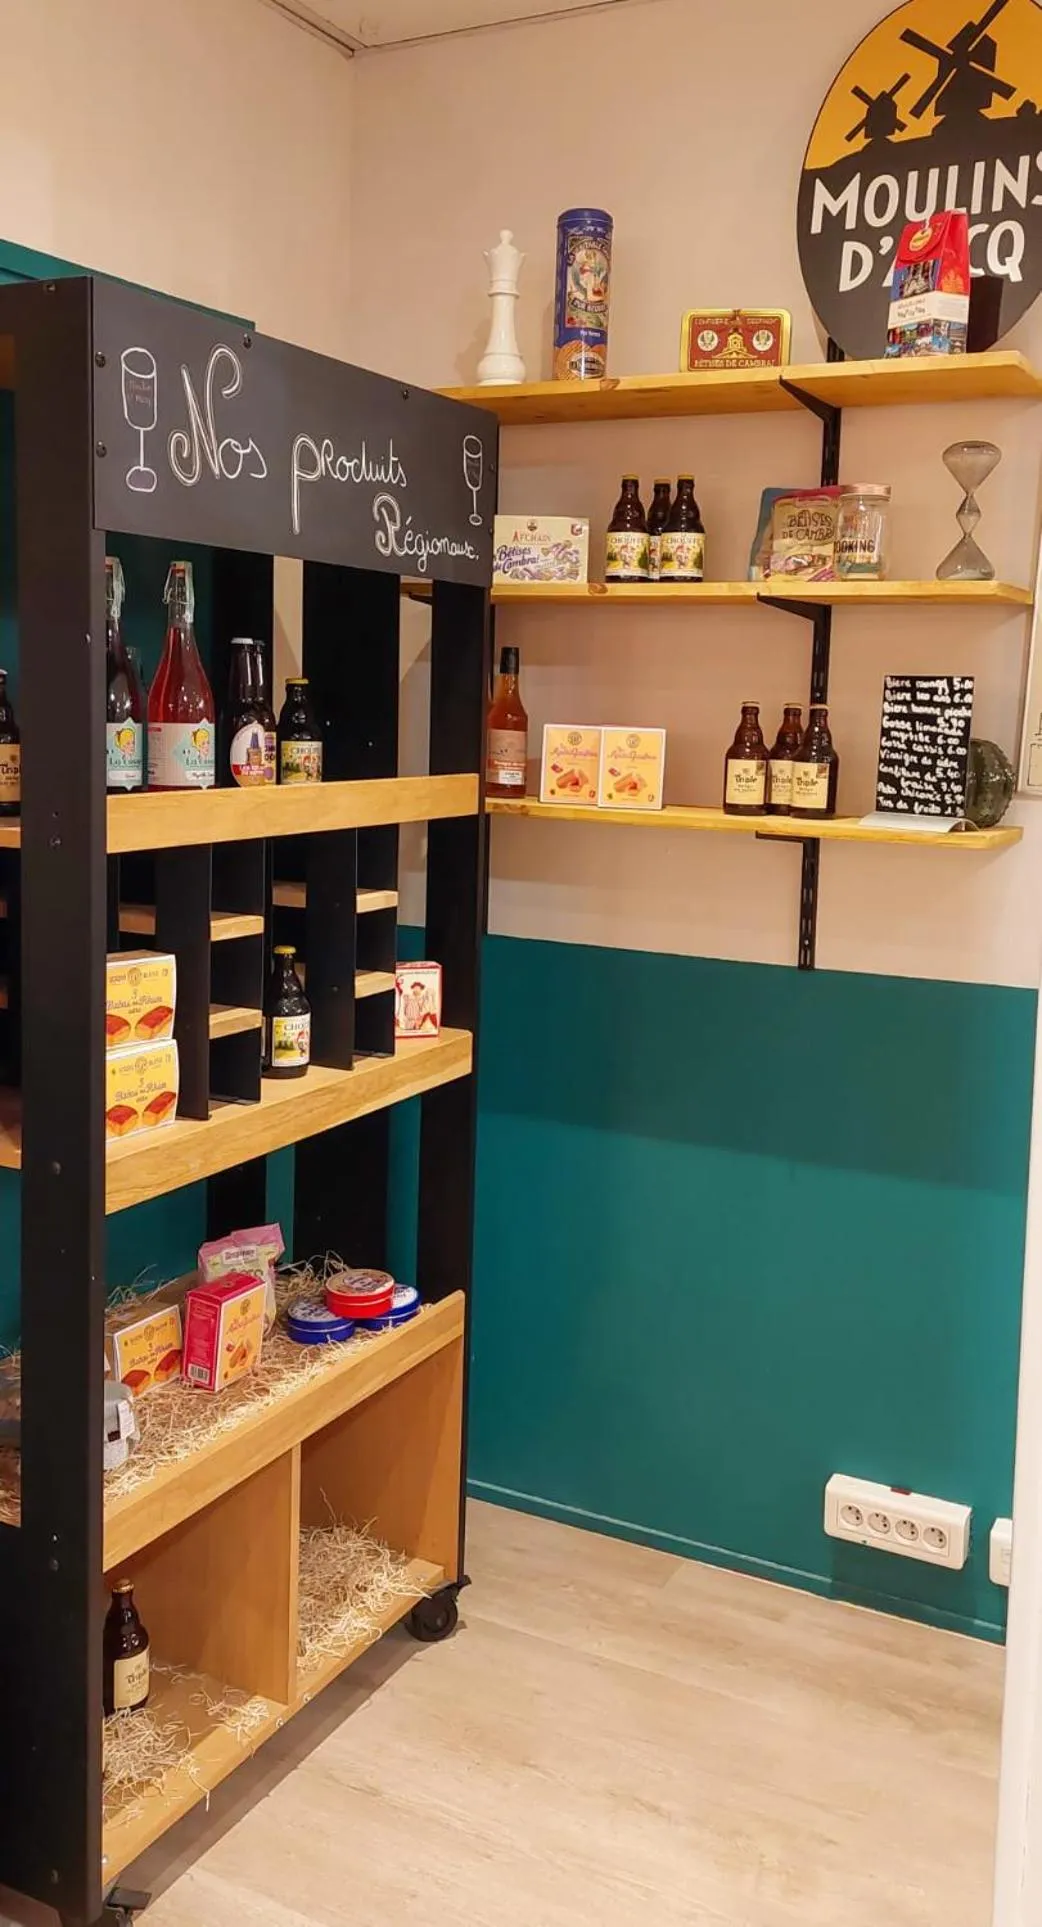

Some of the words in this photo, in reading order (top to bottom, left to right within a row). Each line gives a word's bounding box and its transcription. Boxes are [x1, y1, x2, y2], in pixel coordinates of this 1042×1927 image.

[838, 220, 1025, 292] D'CQ
[167, 343, 267, 486] Nos
[782, 531, 793, 540] DE
[834, 539, 876, 554] OOKING
